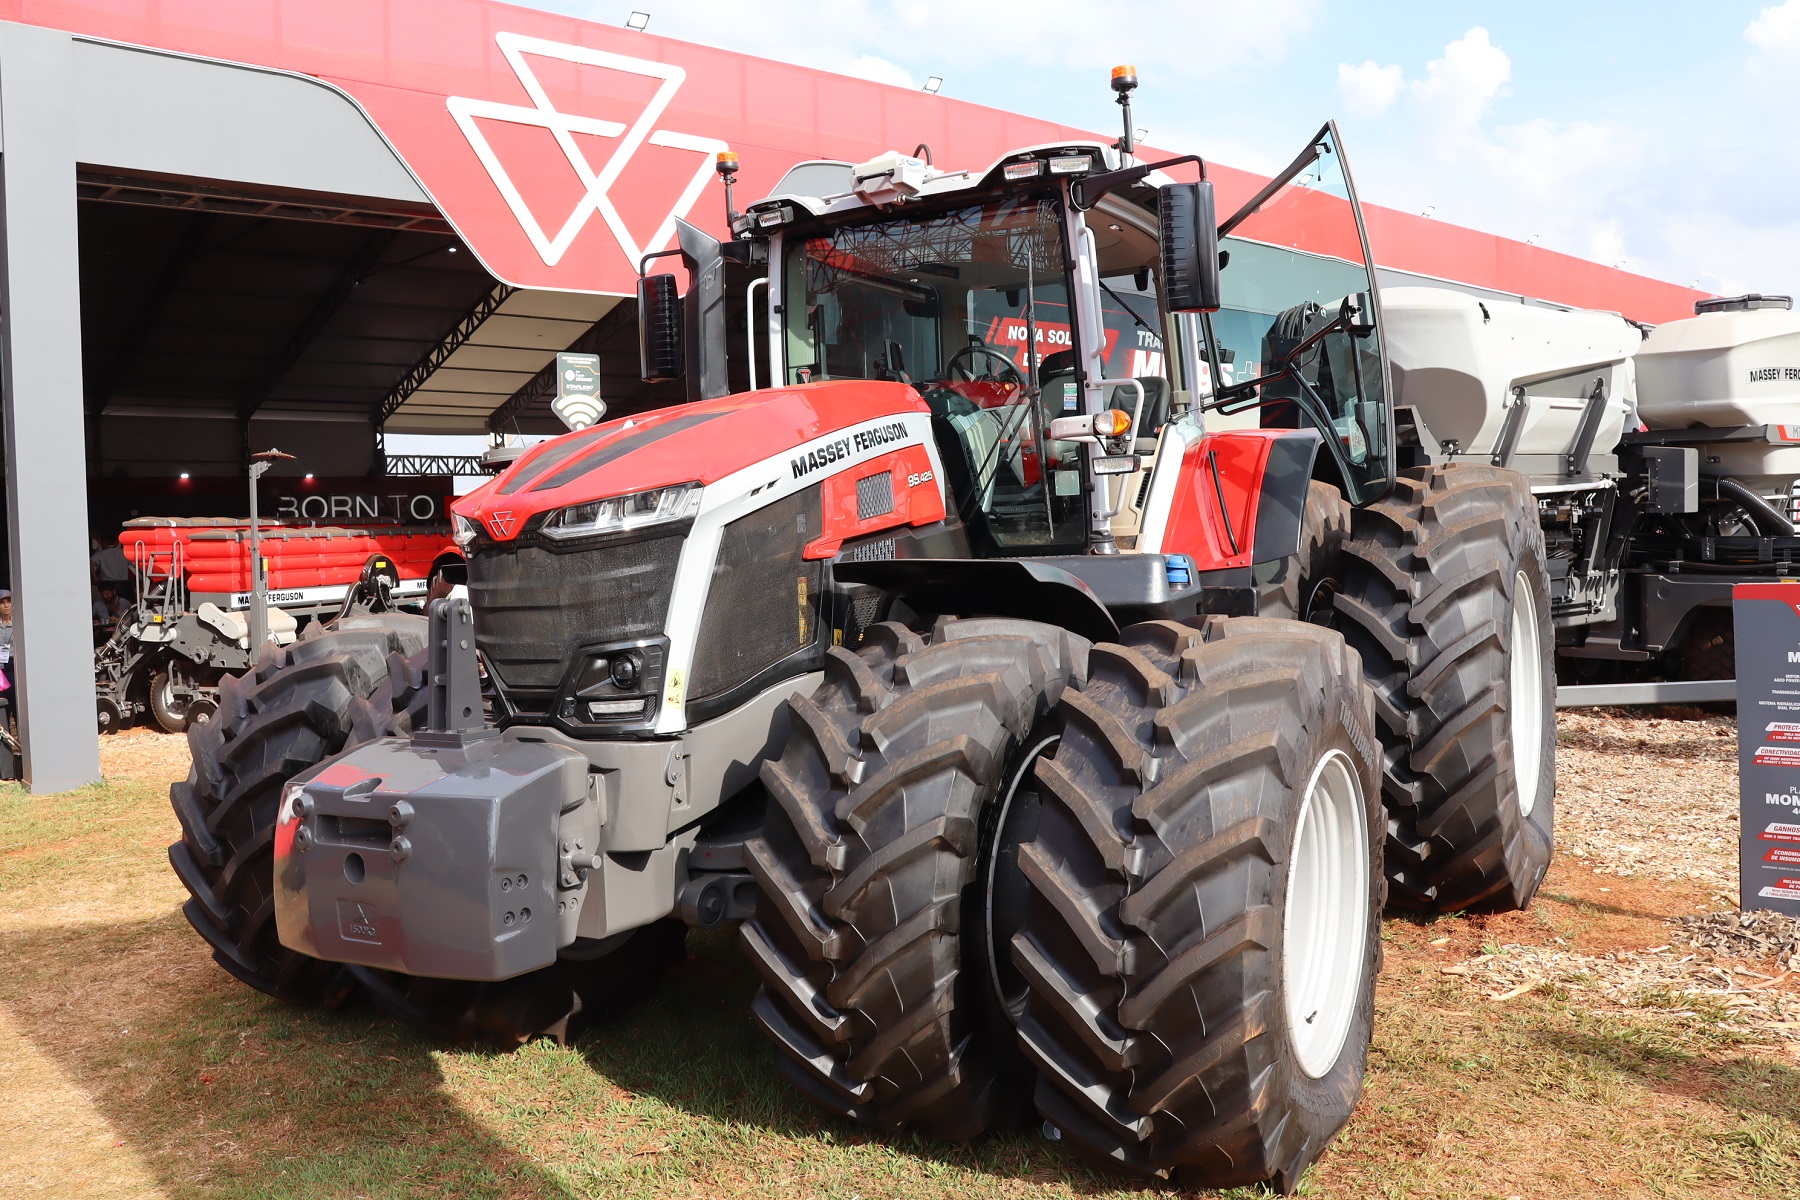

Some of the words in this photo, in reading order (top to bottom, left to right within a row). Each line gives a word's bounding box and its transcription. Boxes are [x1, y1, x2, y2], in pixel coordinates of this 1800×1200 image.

[1008, 325, 1044, 342] NOA
[1749, 368, 1781, 383] MASSEY
[790, 437, 850, 480] MASSEY
[853, 422, 909, 453] FERGUSON
[277, 494, 379, 518] BORN
[387, 494, 435, 521] TO
[268, 592, 304, 602] FERGUSON
